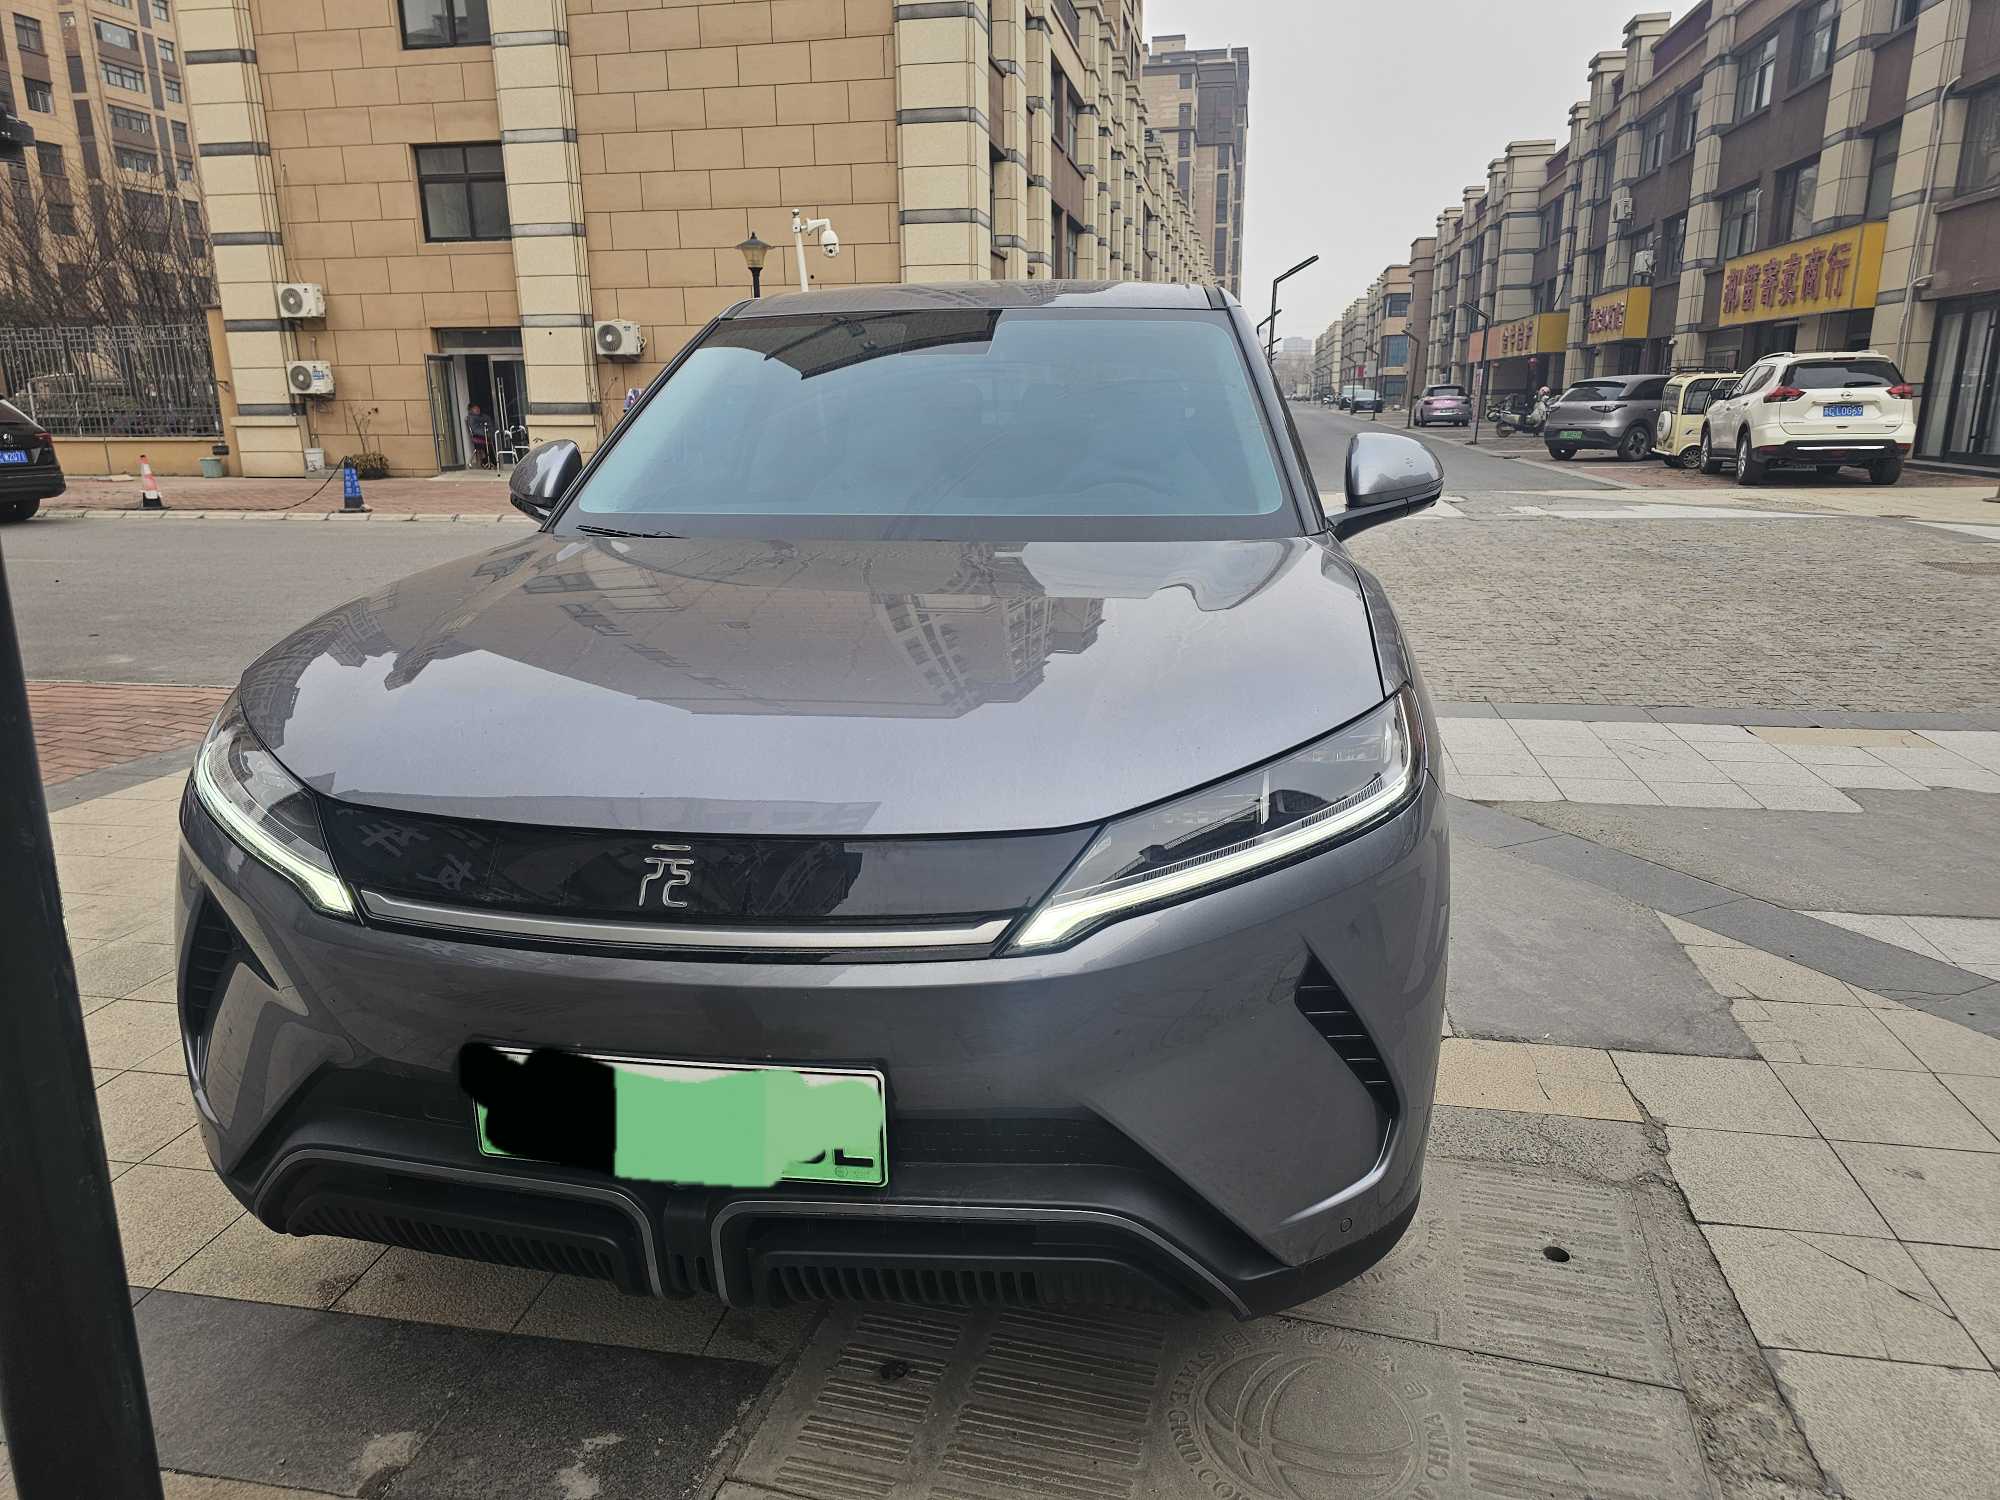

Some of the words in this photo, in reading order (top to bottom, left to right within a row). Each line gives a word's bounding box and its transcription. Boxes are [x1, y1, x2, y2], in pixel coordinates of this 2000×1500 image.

[639, 844, 694, 908] 元
[1167, 1408, 1206, 1466] GRID
[1423, 1412, 1452, 1482] CHINA
